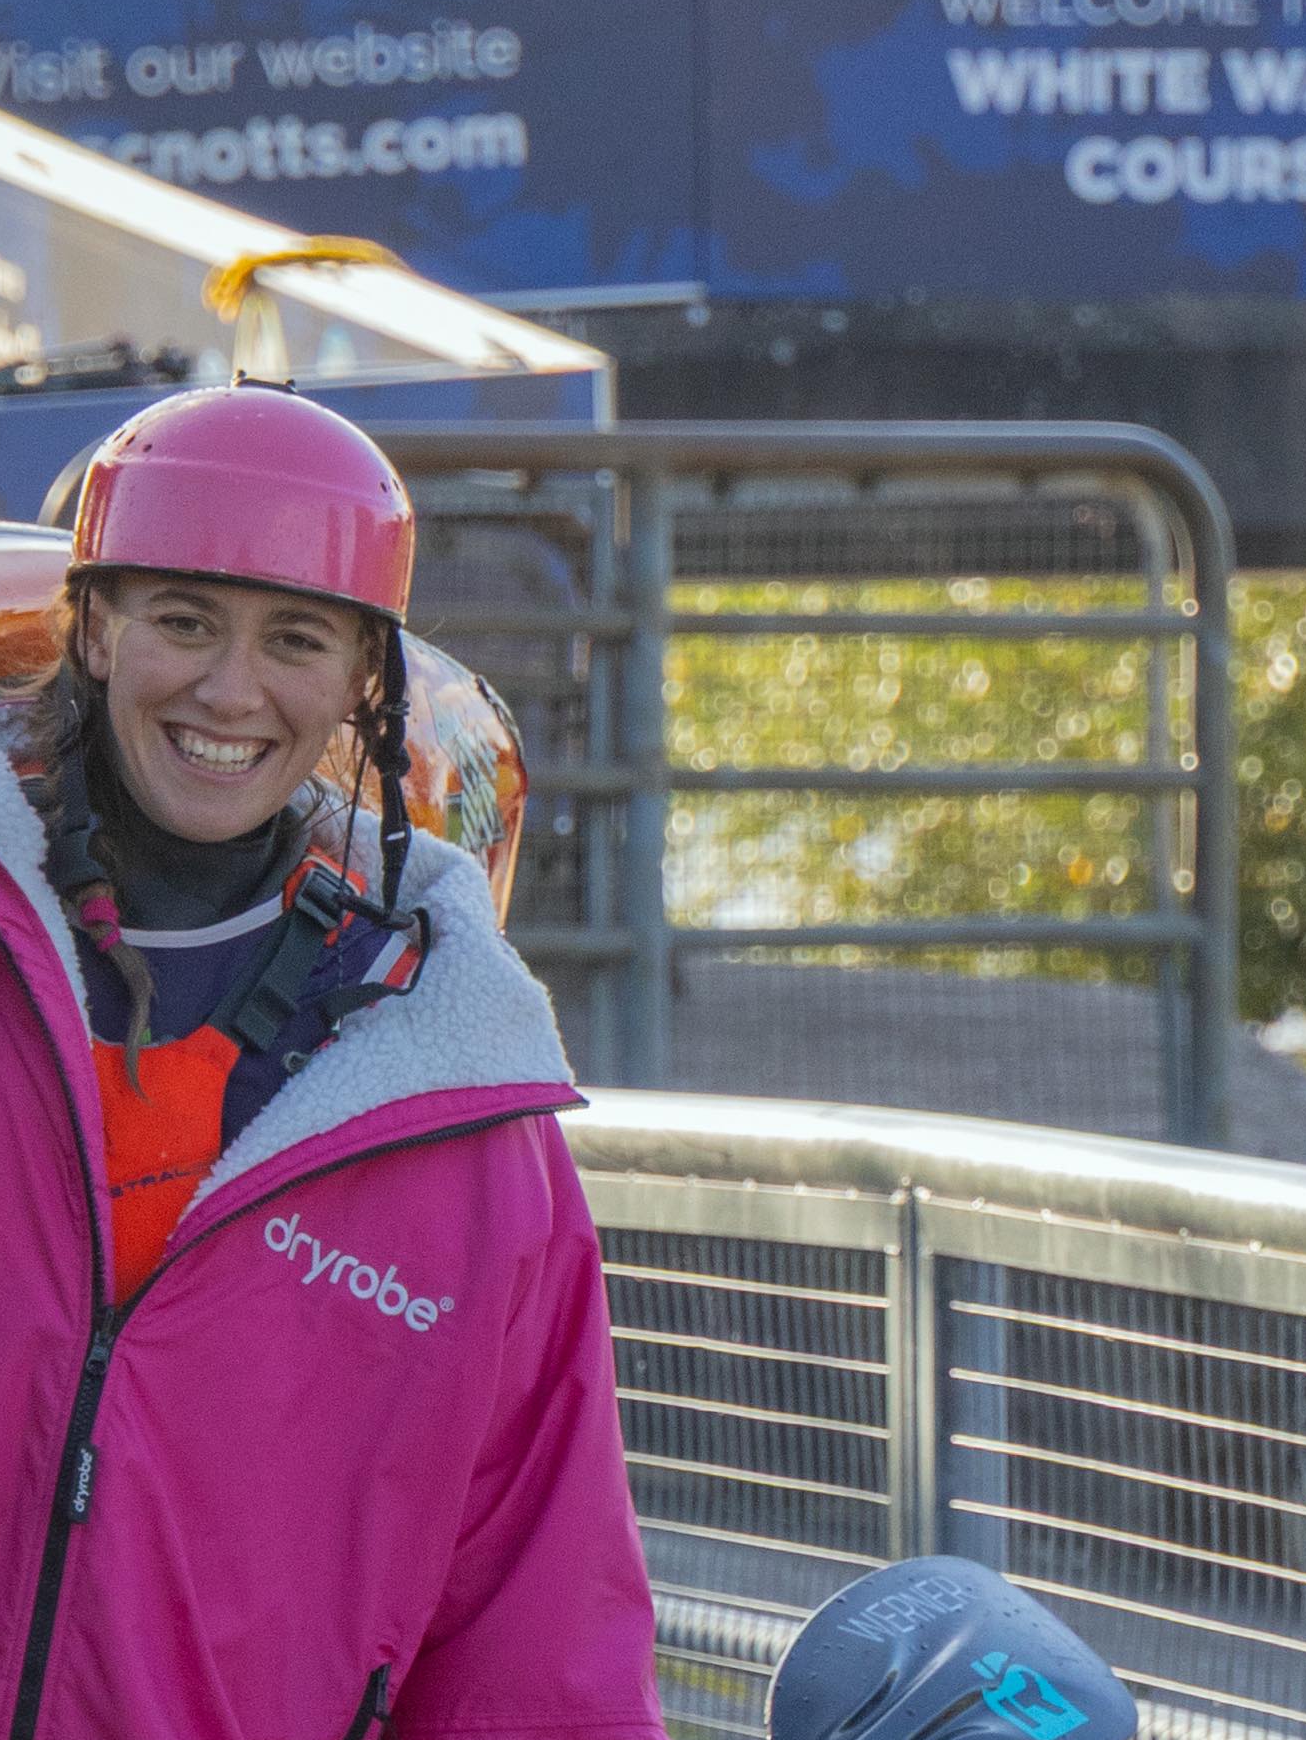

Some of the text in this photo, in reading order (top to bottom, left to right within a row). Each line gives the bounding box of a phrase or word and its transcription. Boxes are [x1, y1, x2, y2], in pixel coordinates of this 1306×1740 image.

[125, 40, 245, 97] our
[257, 20, 523, 89] website
[946, 47, 1212, 115] WHITE
[72, 112, 529, 184] cnotts.com
[73, 1451, 93, 1513] dryrobe
[836, 1574, 978, 1644] WERNER
